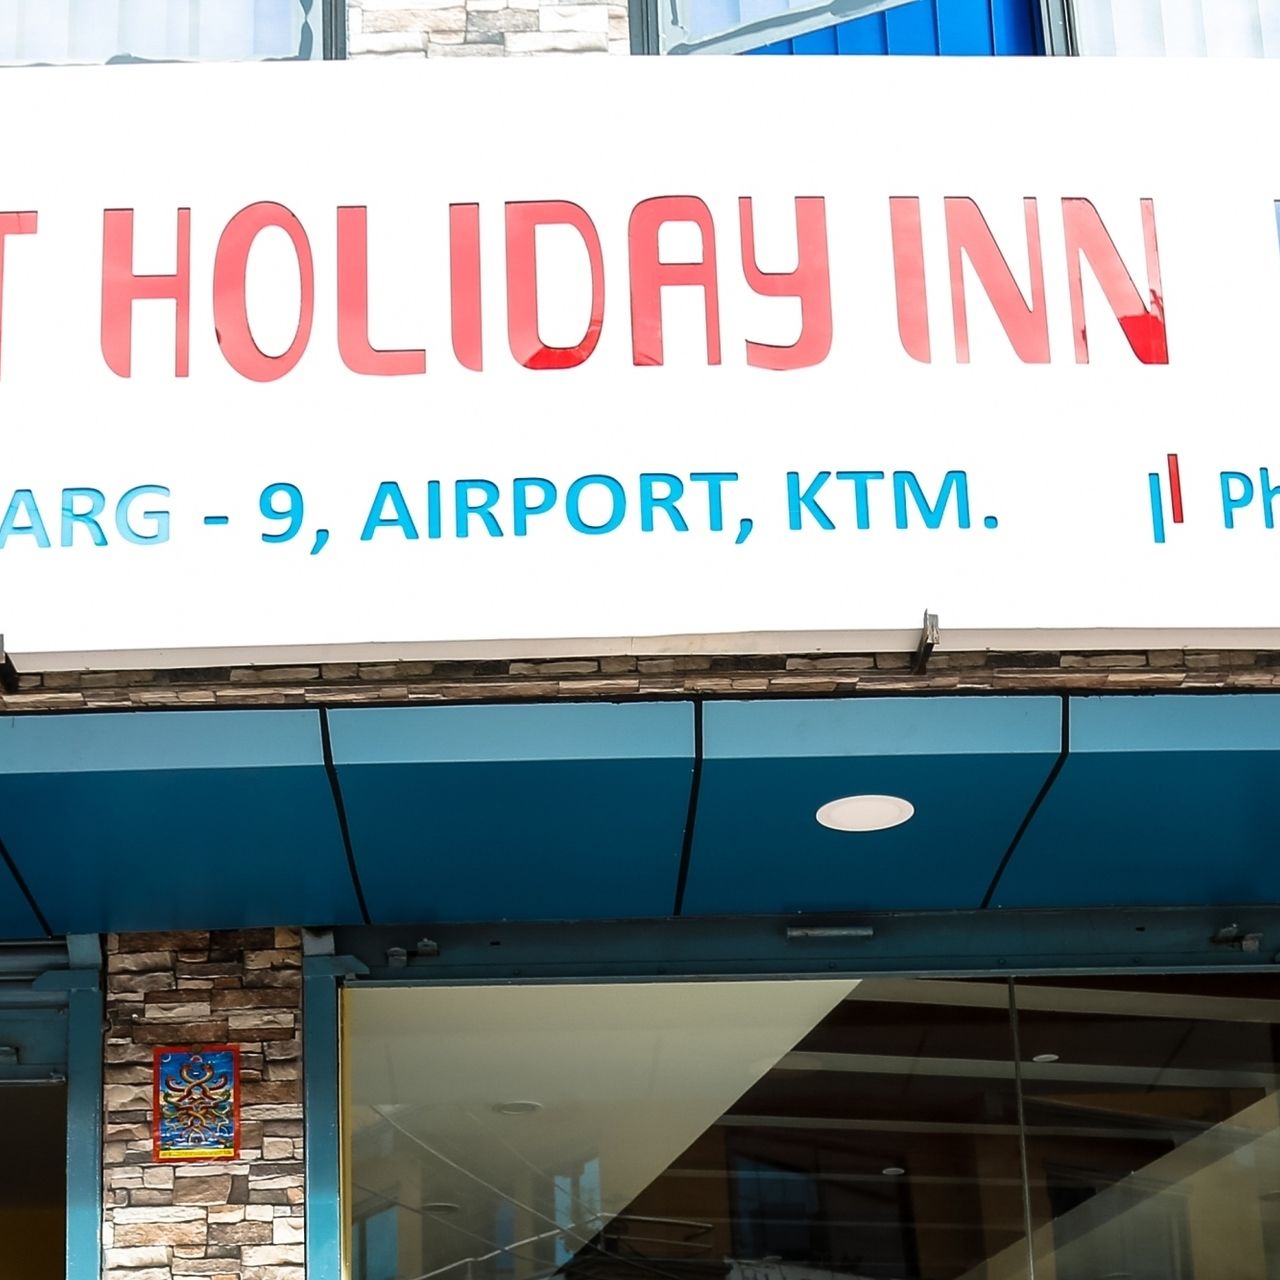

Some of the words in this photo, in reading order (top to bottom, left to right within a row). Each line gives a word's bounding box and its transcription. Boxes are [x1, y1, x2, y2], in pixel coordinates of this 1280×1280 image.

[101, 194, 832, 382] HOLIDAY
[888, 195, 1169, 365] INN
[202, 510, 229, 526] -
[257, 481, 330, 555] 9,
[359, 470, 754, 546] AIRPORT,
[785, 468, 1000, 531] KTM.
